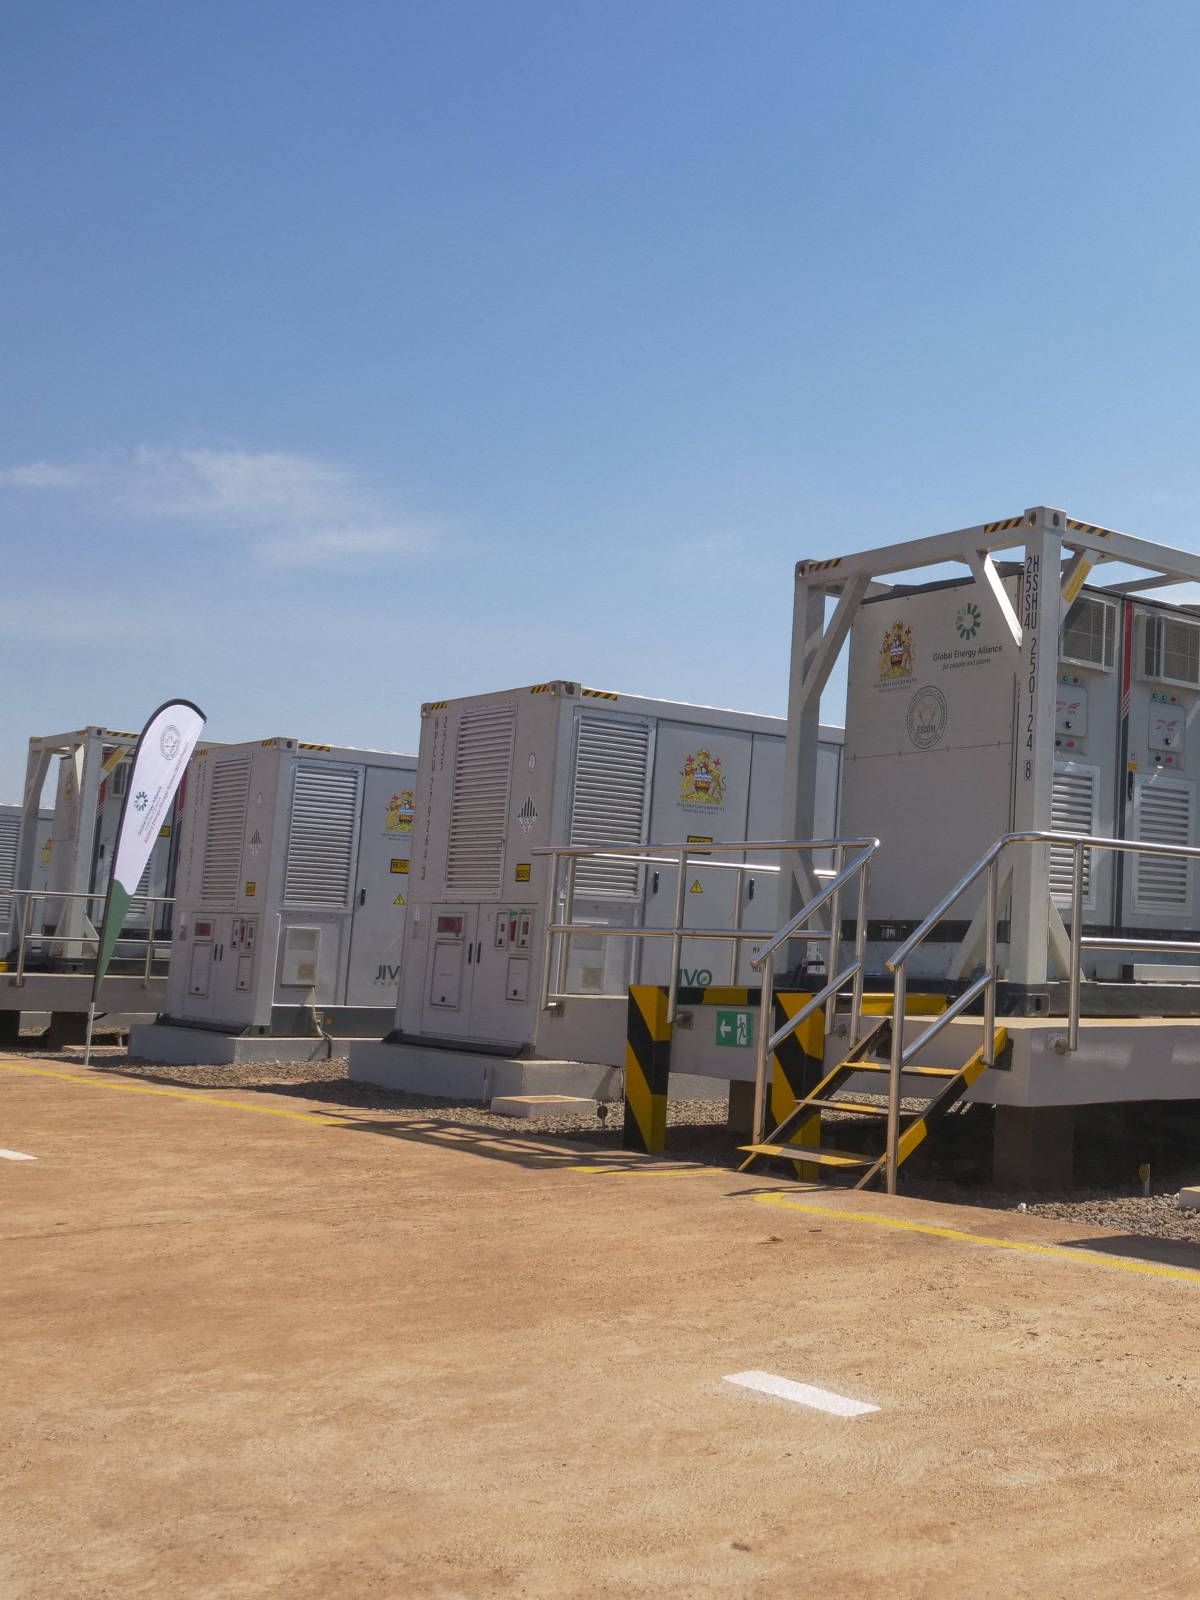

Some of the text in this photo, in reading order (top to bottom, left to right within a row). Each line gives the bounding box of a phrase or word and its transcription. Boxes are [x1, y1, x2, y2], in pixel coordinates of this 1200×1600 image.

[932, 645, 1003, 661] Global Energy Alliance
[1024, 760, 1032, 780] 8
[376, 965, 400, 980] JIV
[678, 969, 713, 986] IVO
